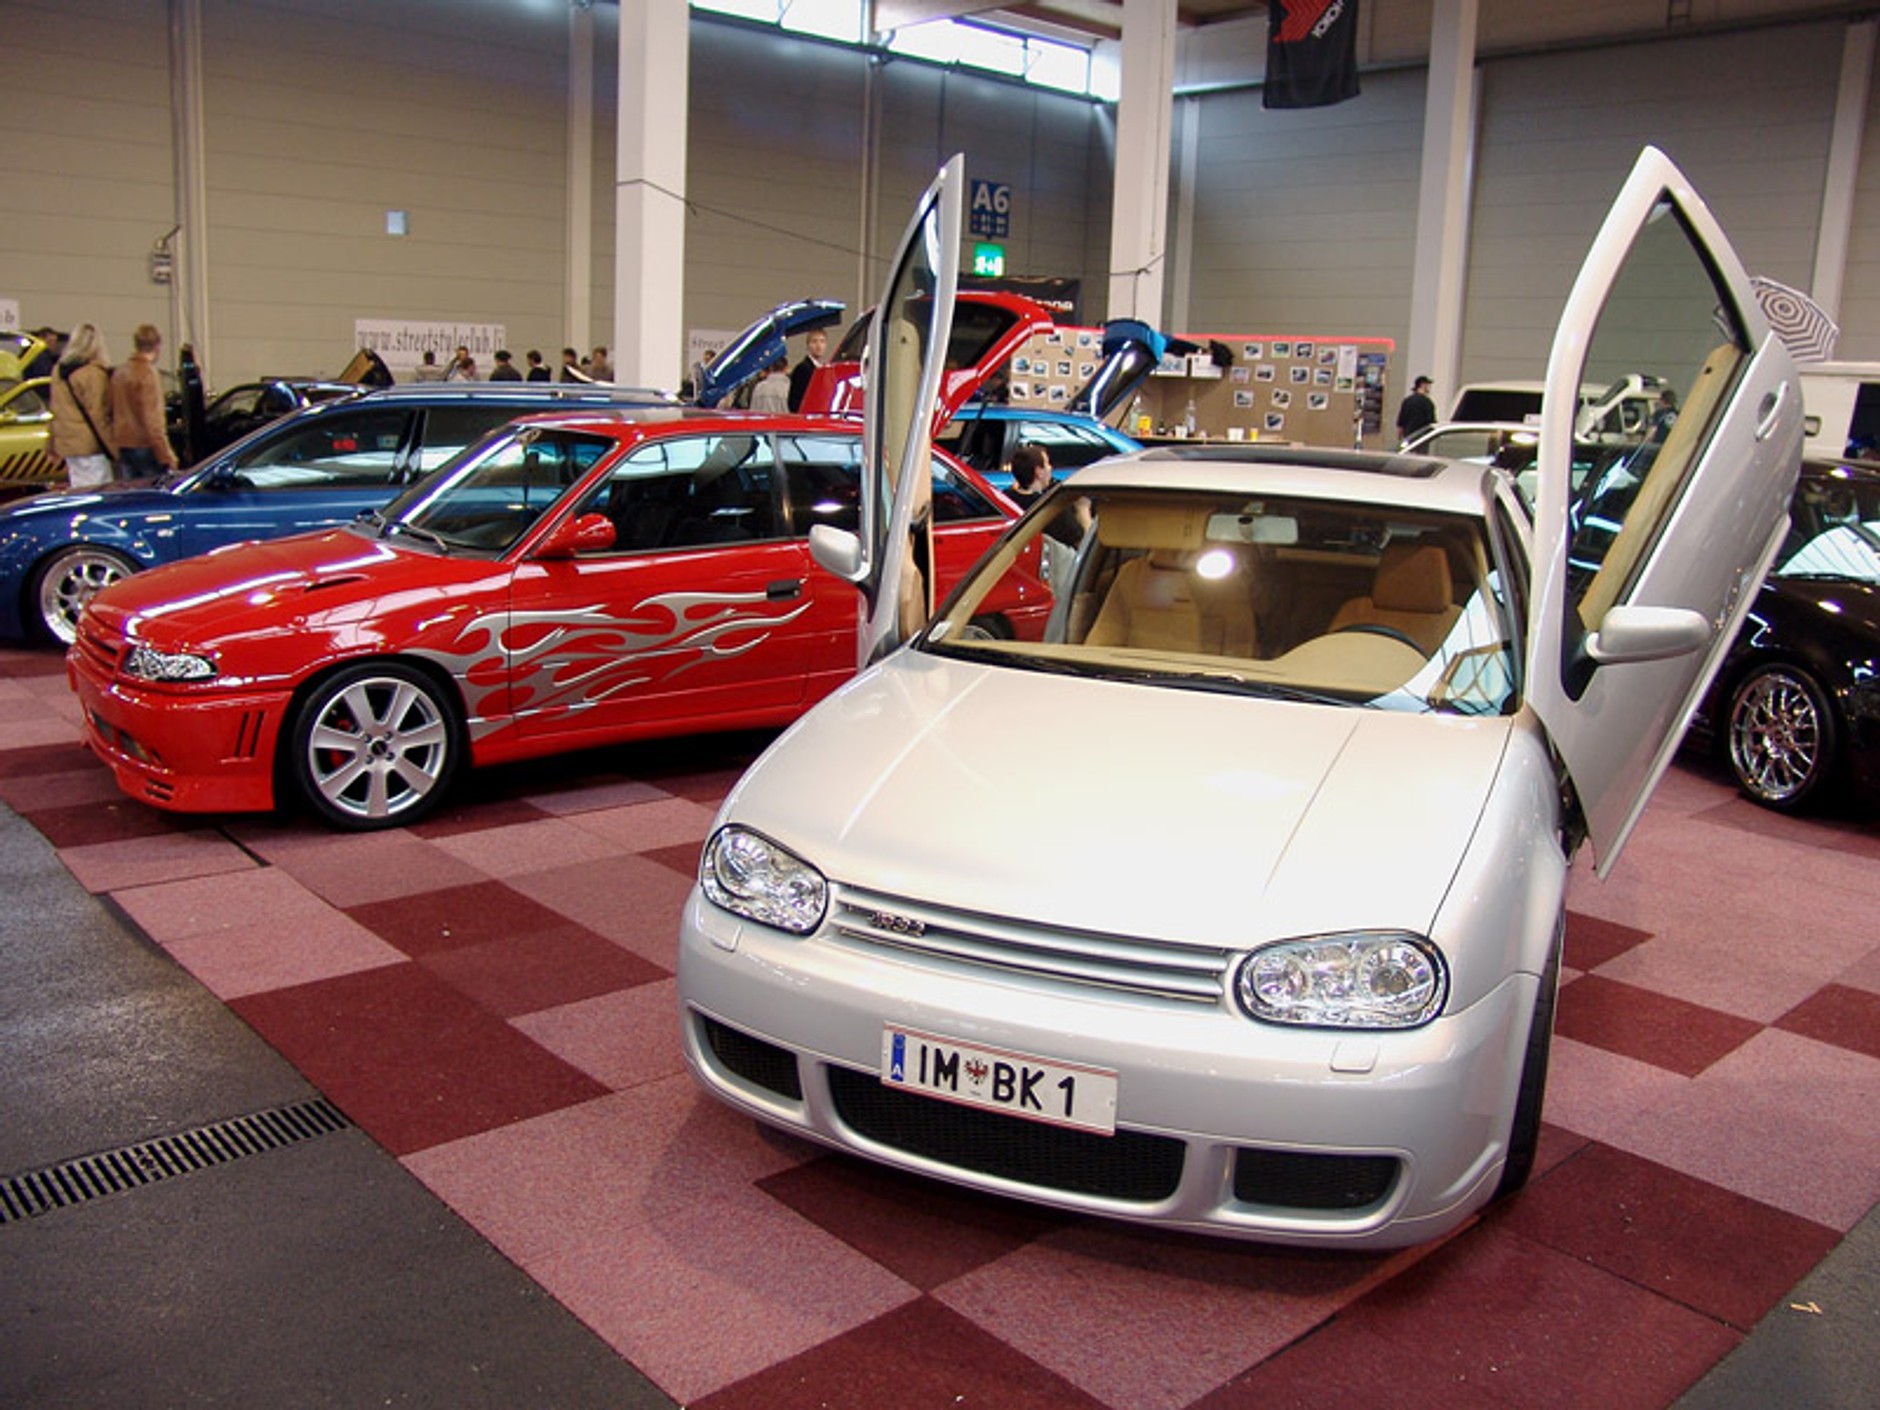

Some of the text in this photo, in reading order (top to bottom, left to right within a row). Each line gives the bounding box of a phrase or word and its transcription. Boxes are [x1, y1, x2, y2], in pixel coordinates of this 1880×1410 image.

[973, 183, 1010, 213] A6
[919, 1043, 1075, 1117] IM BK 1
